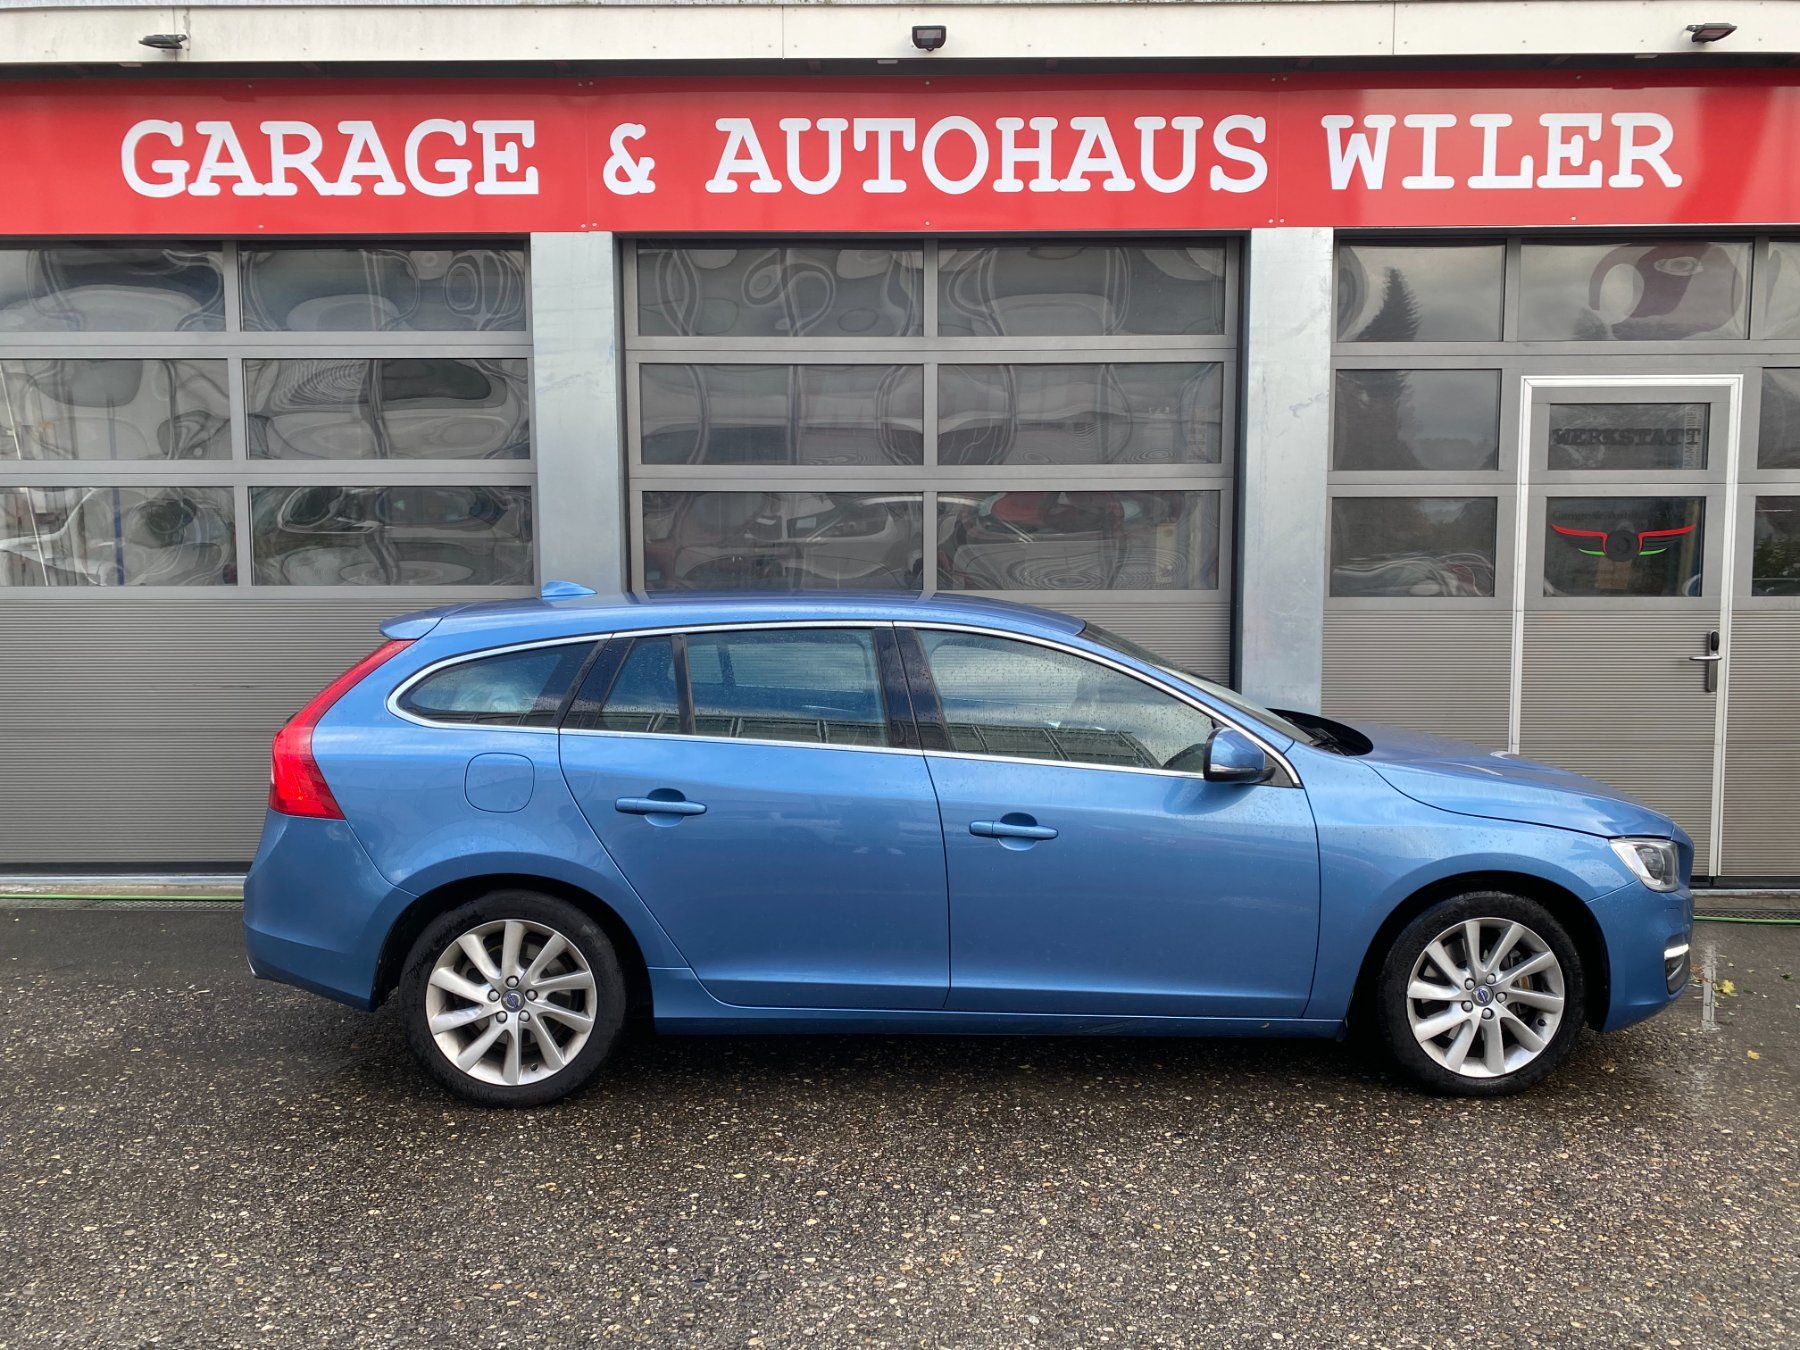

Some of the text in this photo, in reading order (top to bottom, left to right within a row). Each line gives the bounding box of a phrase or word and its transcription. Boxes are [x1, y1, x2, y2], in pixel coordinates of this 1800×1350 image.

[121, 111, 1683, 198] GARAGE & AUTOHAUS WILER
[1551, 427, 1702, 446] WERKSTATT
